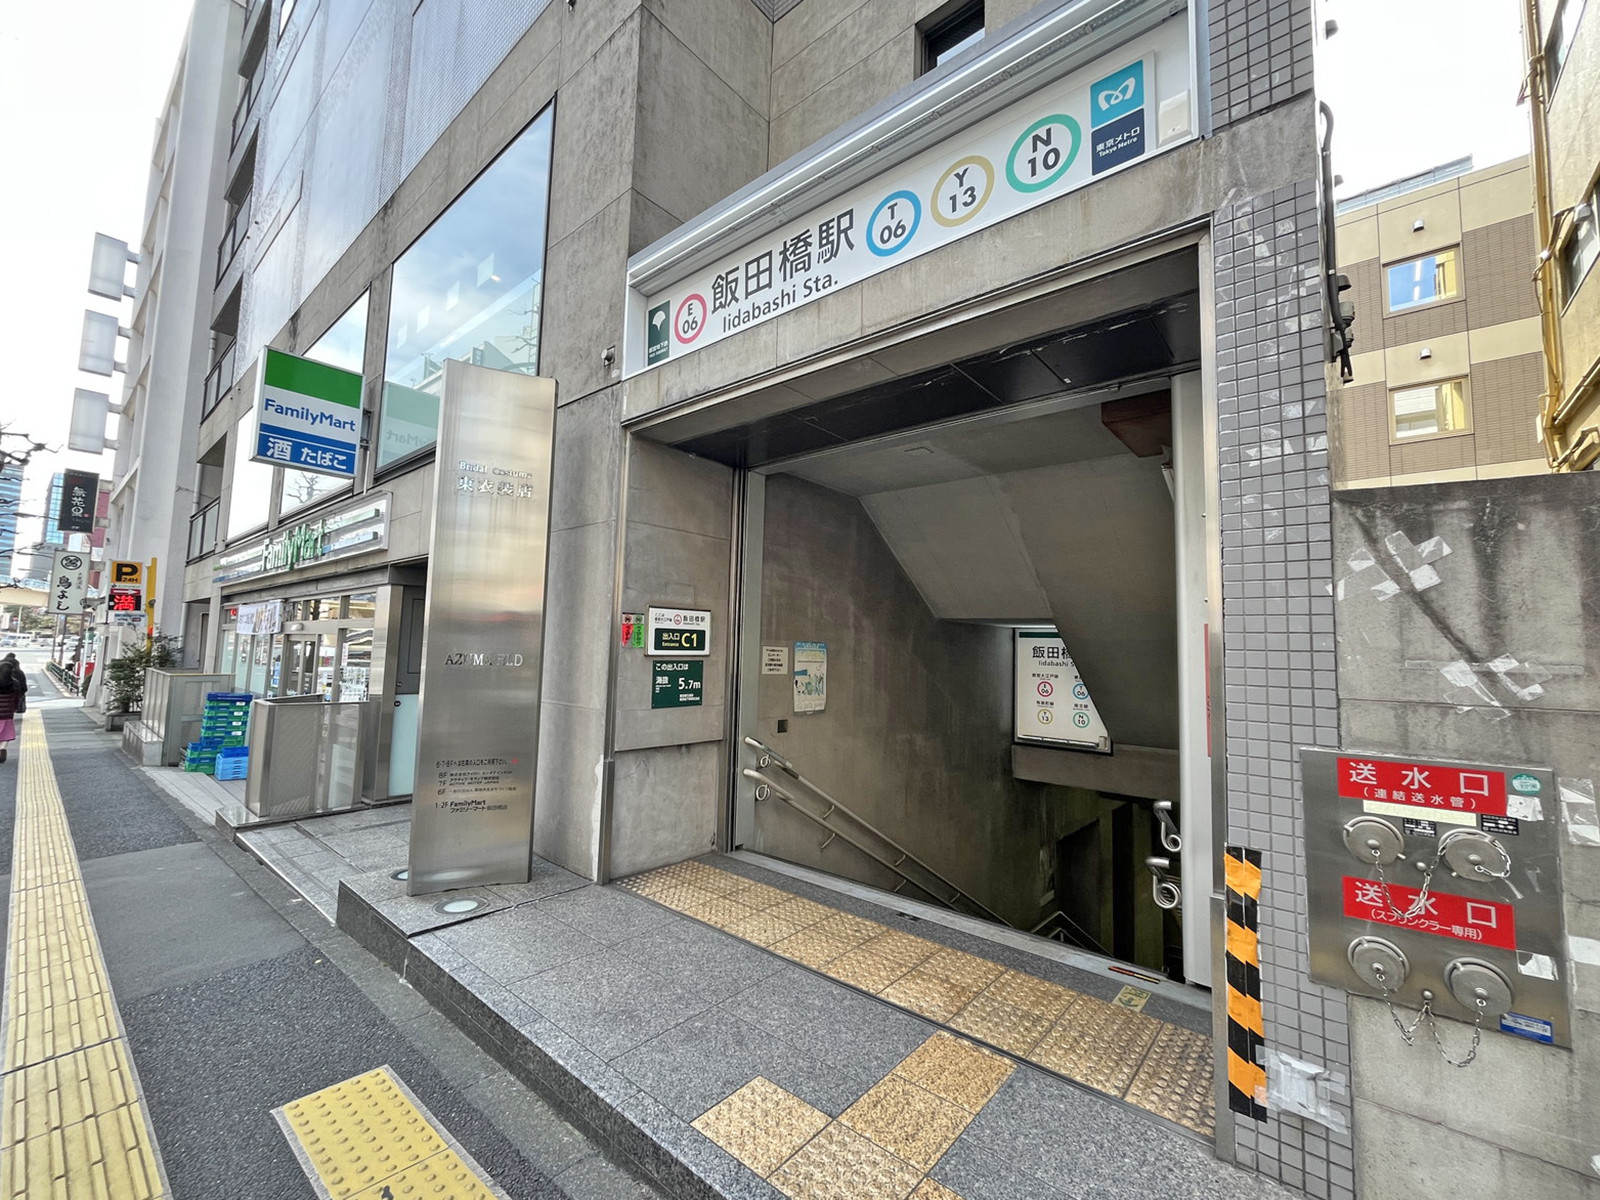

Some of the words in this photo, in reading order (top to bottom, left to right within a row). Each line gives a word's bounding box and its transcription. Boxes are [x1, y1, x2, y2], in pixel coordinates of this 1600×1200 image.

[1032, 128, 1052, 154] N
[1096, 127, 1140, 152] 東京メトロ
[1099, 145, 1118, 157] Tokyo
[1028, 147, 1060, 178] 10
[954, 168, 970, 188] Y
[950, 186, 977, 214] 13
[887, 202, 898, 221] T
[879, 219, 906, 245] 06
[711, 208, 855, 315] 飯田橋駅
[687, 303, 694, 317] E
[723, 284, 796, 333] Iidabashi
[803, 272, 838, 299] Sta.
[682, 316, 698, 335] 06
[264, 398, 356, 432] FamilyMart
[267, 436, 292, 461] 酒
[301, 446, 347, 470] たばこ
[459, 460, 487, 474] Bridal
[116, 563, 138, 582] P
[113, 595, 136, 611] 満
[662, 632, 680, 640] 出入口
[681, 632, 697, 647] C1
[655, 663, 689, 671] この出入口は
[678, 677, 701, 690] 5.7m
[1349, 762, 1489, 797] 送水口
[1355, 881, 1497, 928] 送水口
